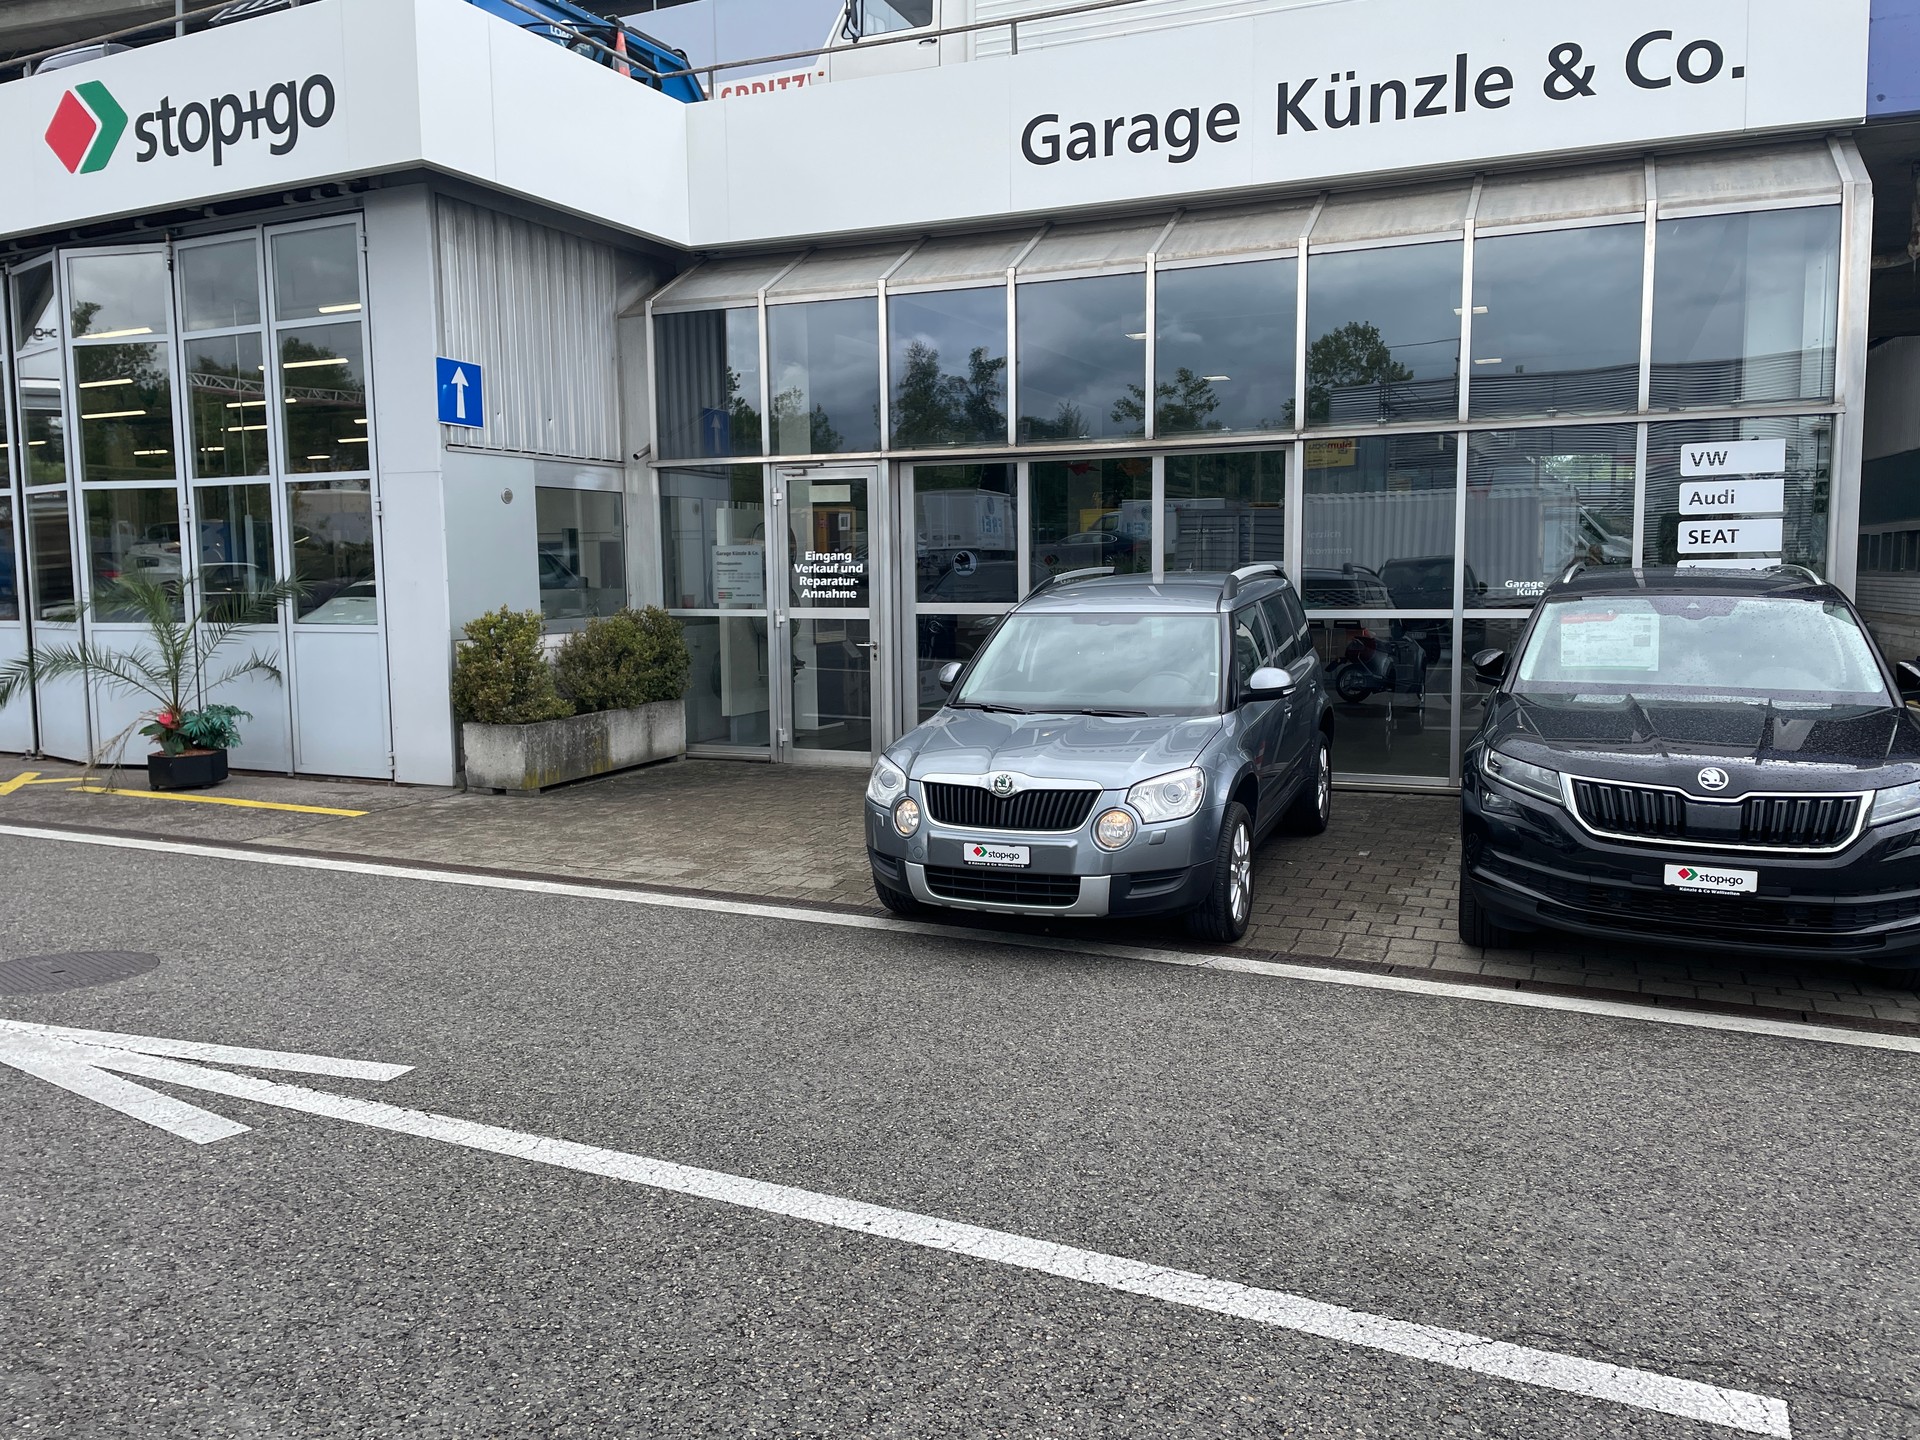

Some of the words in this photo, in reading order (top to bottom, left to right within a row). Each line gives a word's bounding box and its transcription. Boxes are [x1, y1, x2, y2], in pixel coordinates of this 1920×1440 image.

[1021, 102, 1240, 165] Garage
[1276, 53, 1514, 135] Künzle
[1543, 42, 1596, 100] &
[1625, 30, 1746, 89] Co.
[135, 74, 335, 166] stop+go
[1690, 451, 1728, 467] VW
[1689, 489, 1735, 505] Audi
[1688, 529, 1740, 545] SEAT
[805, 551, 852, 563] Eingang
[794, 564, 838, 573] Verkauf
[841, 564, 863, 573] und
[799, 576, 859, 588] Reparatur-
[1505, 580, 1544, 590] Garage
[801, 589, 857, 598] Annahme
[1516, 588, 1545, 596] Künz
[988, 851, 1020, 861] stop+go
[1699, 874, 1743, 886] stop+go
